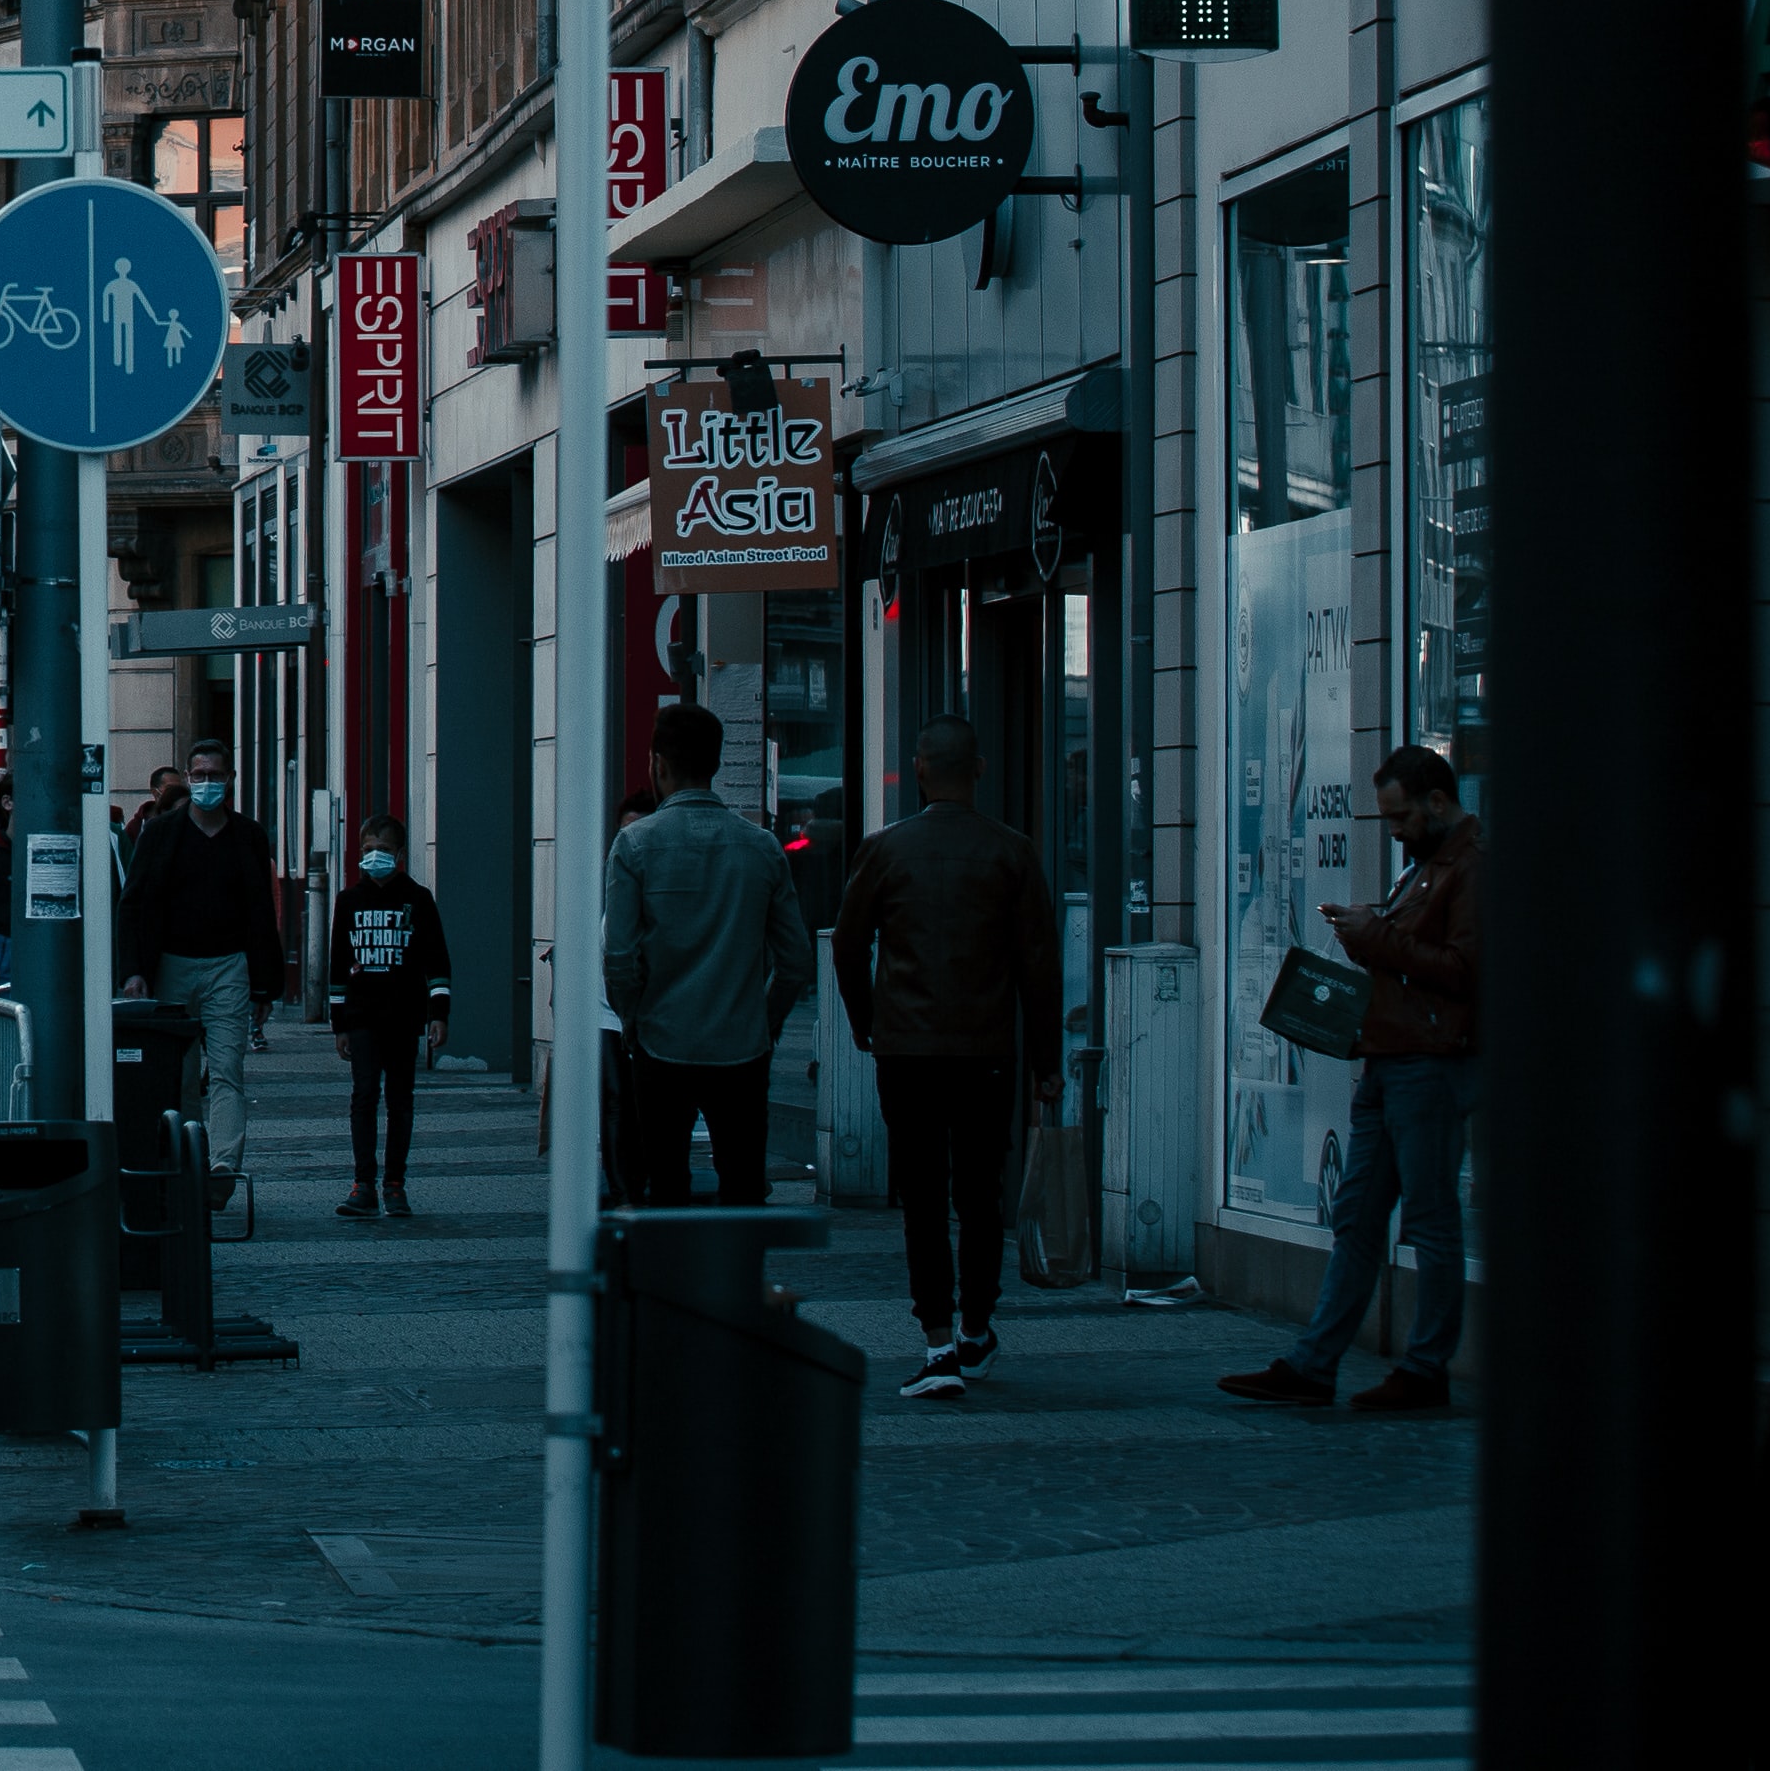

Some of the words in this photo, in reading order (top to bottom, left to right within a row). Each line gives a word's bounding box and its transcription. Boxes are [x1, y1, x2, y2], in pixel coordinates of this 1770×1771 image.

[824, 55, 1014, 144] Emo
[837, 153, 900, 168] MAÎTRE
[910, 156, 992, 168] BOUCHER
[608, 78, 647, 325] ESPIT
[356, 261, 403, 452] ESPRIT
[278, 404, 304, 415] BCP
[662, 406, 822, 469] Little
[677, 476, 816, 538] Asia
[662, 551, 704, 567] Mixed
[706, 549, 746, 565] Asian
[746, 548, 791, 563] Street
[792, 545, 828, 562] Food
[239, 618, 286, 631] BANQUE
[288, 615, 310, 628] BC
[1307, 606, 1351, 673] PATYK
[1318, 833, 1331, 868] DU
[1331, 833, 1348, 868] BIO
[354, 909, 404, 928] CRAFT
[348, 928, 413, 948] WITHOUT
[354, 947, 404, 966] LIMITS
